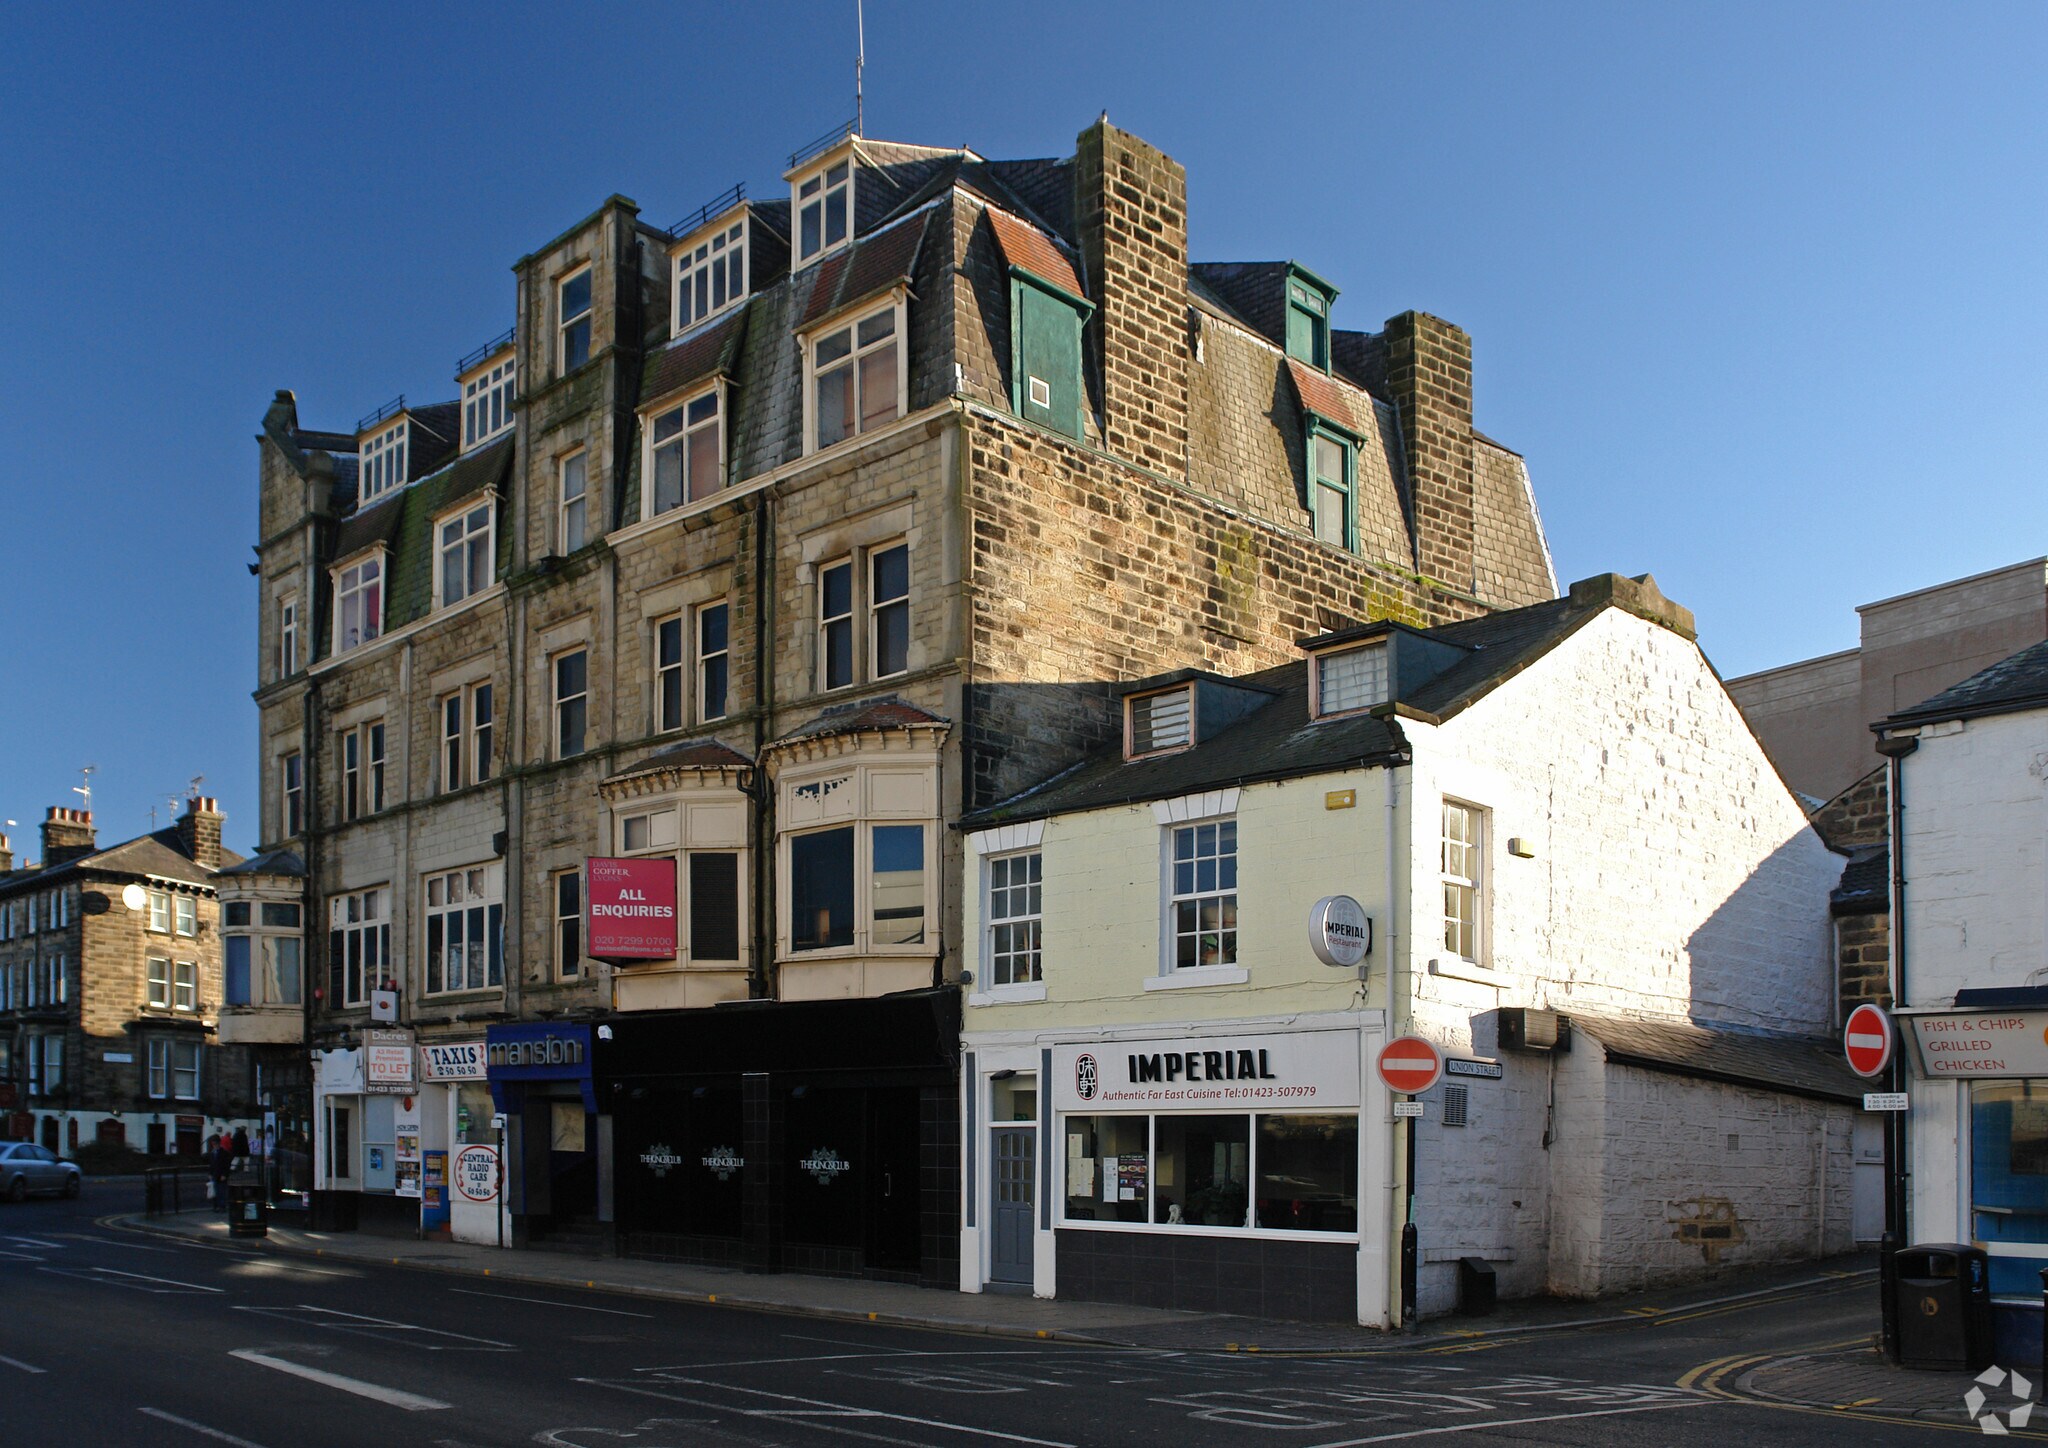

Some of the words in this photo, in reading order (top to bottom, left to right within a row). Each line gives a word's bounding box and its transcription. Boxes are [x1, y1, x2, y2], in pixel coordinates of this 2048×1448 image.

[593, 867, 631, 877] COFFER
[618, 889, 646, 901] ALL
[592, 904, 673, 918] ENQUIRIES
[594, 936, 614, 945] 020
[646, 937, 672, 946] 0700
[1328, 935, 1362, 949] Restaurant
[1923, 1021, 1957, 1032] FISH
[1962, 1020, 1974, 1031] &
[1978, 1018, 2025, 1031] CHIPS
[372, 1031, 408, 1040] Dacres
[489, 1034, 582, 1065] mansion
[1928, 1040, 1992, 1052] GRILLED
[431, 1047, 477, 1065] TAXIS
[371, 1063, 386, 1074] TO
[389, 1063, 410, 1074] LET
[445, 1066, 454, 1075] 50
[457, 1066, 466, 1075] 50
[468, 1066, 477, 1075] 50
[1128, 1049, 1276, 1083] IMPERIAL
[1450, 1061, 1474, 1073] UNION
[1476, 1065, 1500, 1076] STREET
[1934, 1060, 2006, 1071] CHICKEN
[1102, 1090, 1145, 1101] Authentic
[1147, 1090, 1163, 1100] Far
[1165, 1089, 1184, 1100] East
[1187, 1088, 1222, 1099] Cuisine
[463, 1154, 494, 1164] CENTRAL
[467, 1163, 489, 1173] RADIO
[469, 1172, 488, 1182] CARS
[468, 1187, 475, 1196] 50
[475, 1187, 483, 1196] 50
[483, 1187, 491, 1196] 50
